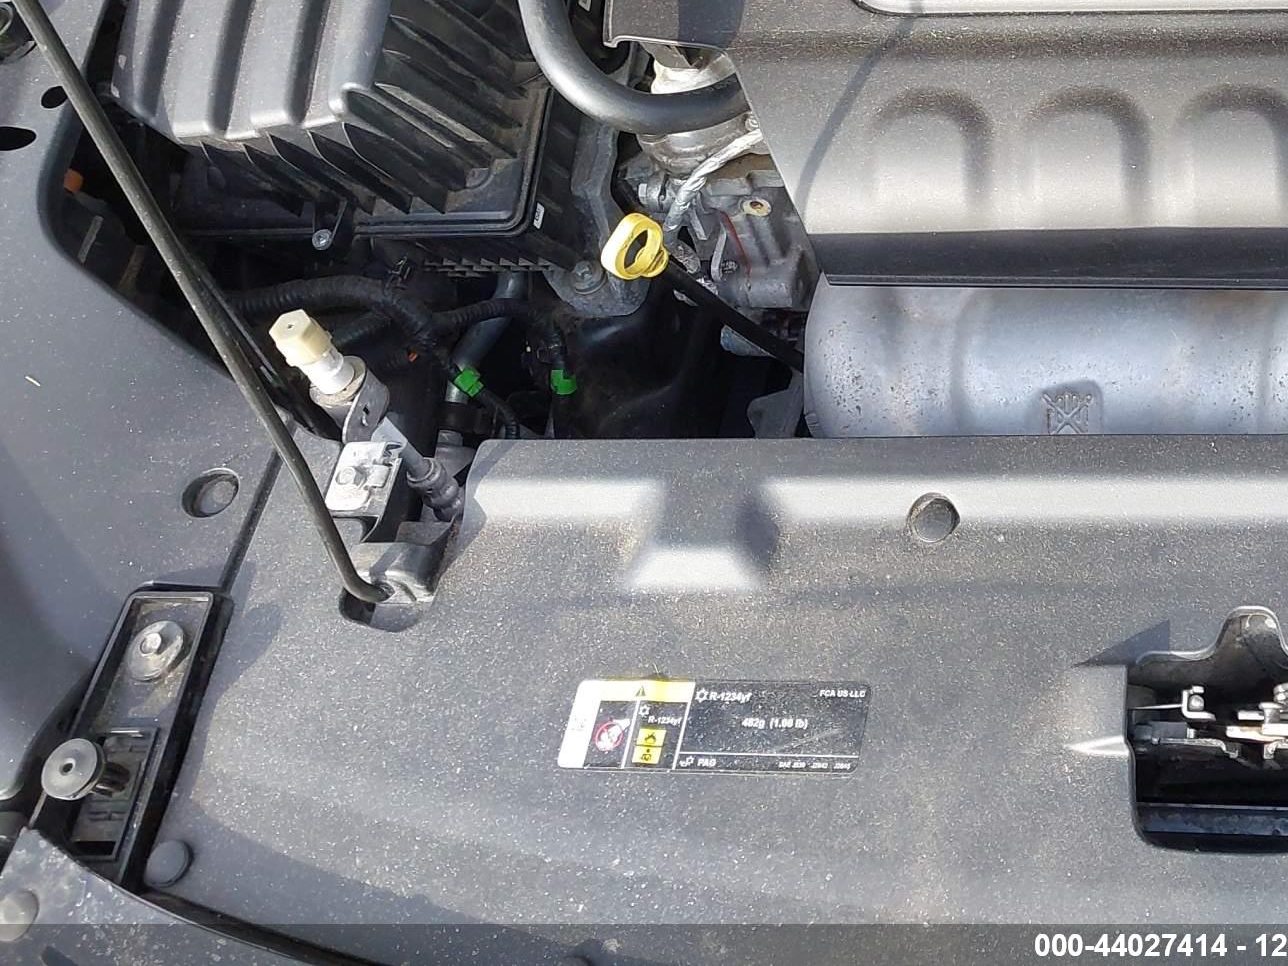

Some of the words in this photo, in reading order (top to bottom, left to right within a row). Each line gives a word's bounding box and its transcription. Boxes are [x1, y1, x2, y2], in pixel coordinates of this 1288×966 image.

[708, 690, 753, 703] R-1234yf
[819, 689, 836, 698] FCA
[837, 689, 848, 698] US
[849, 689, 866, 698] LLC
